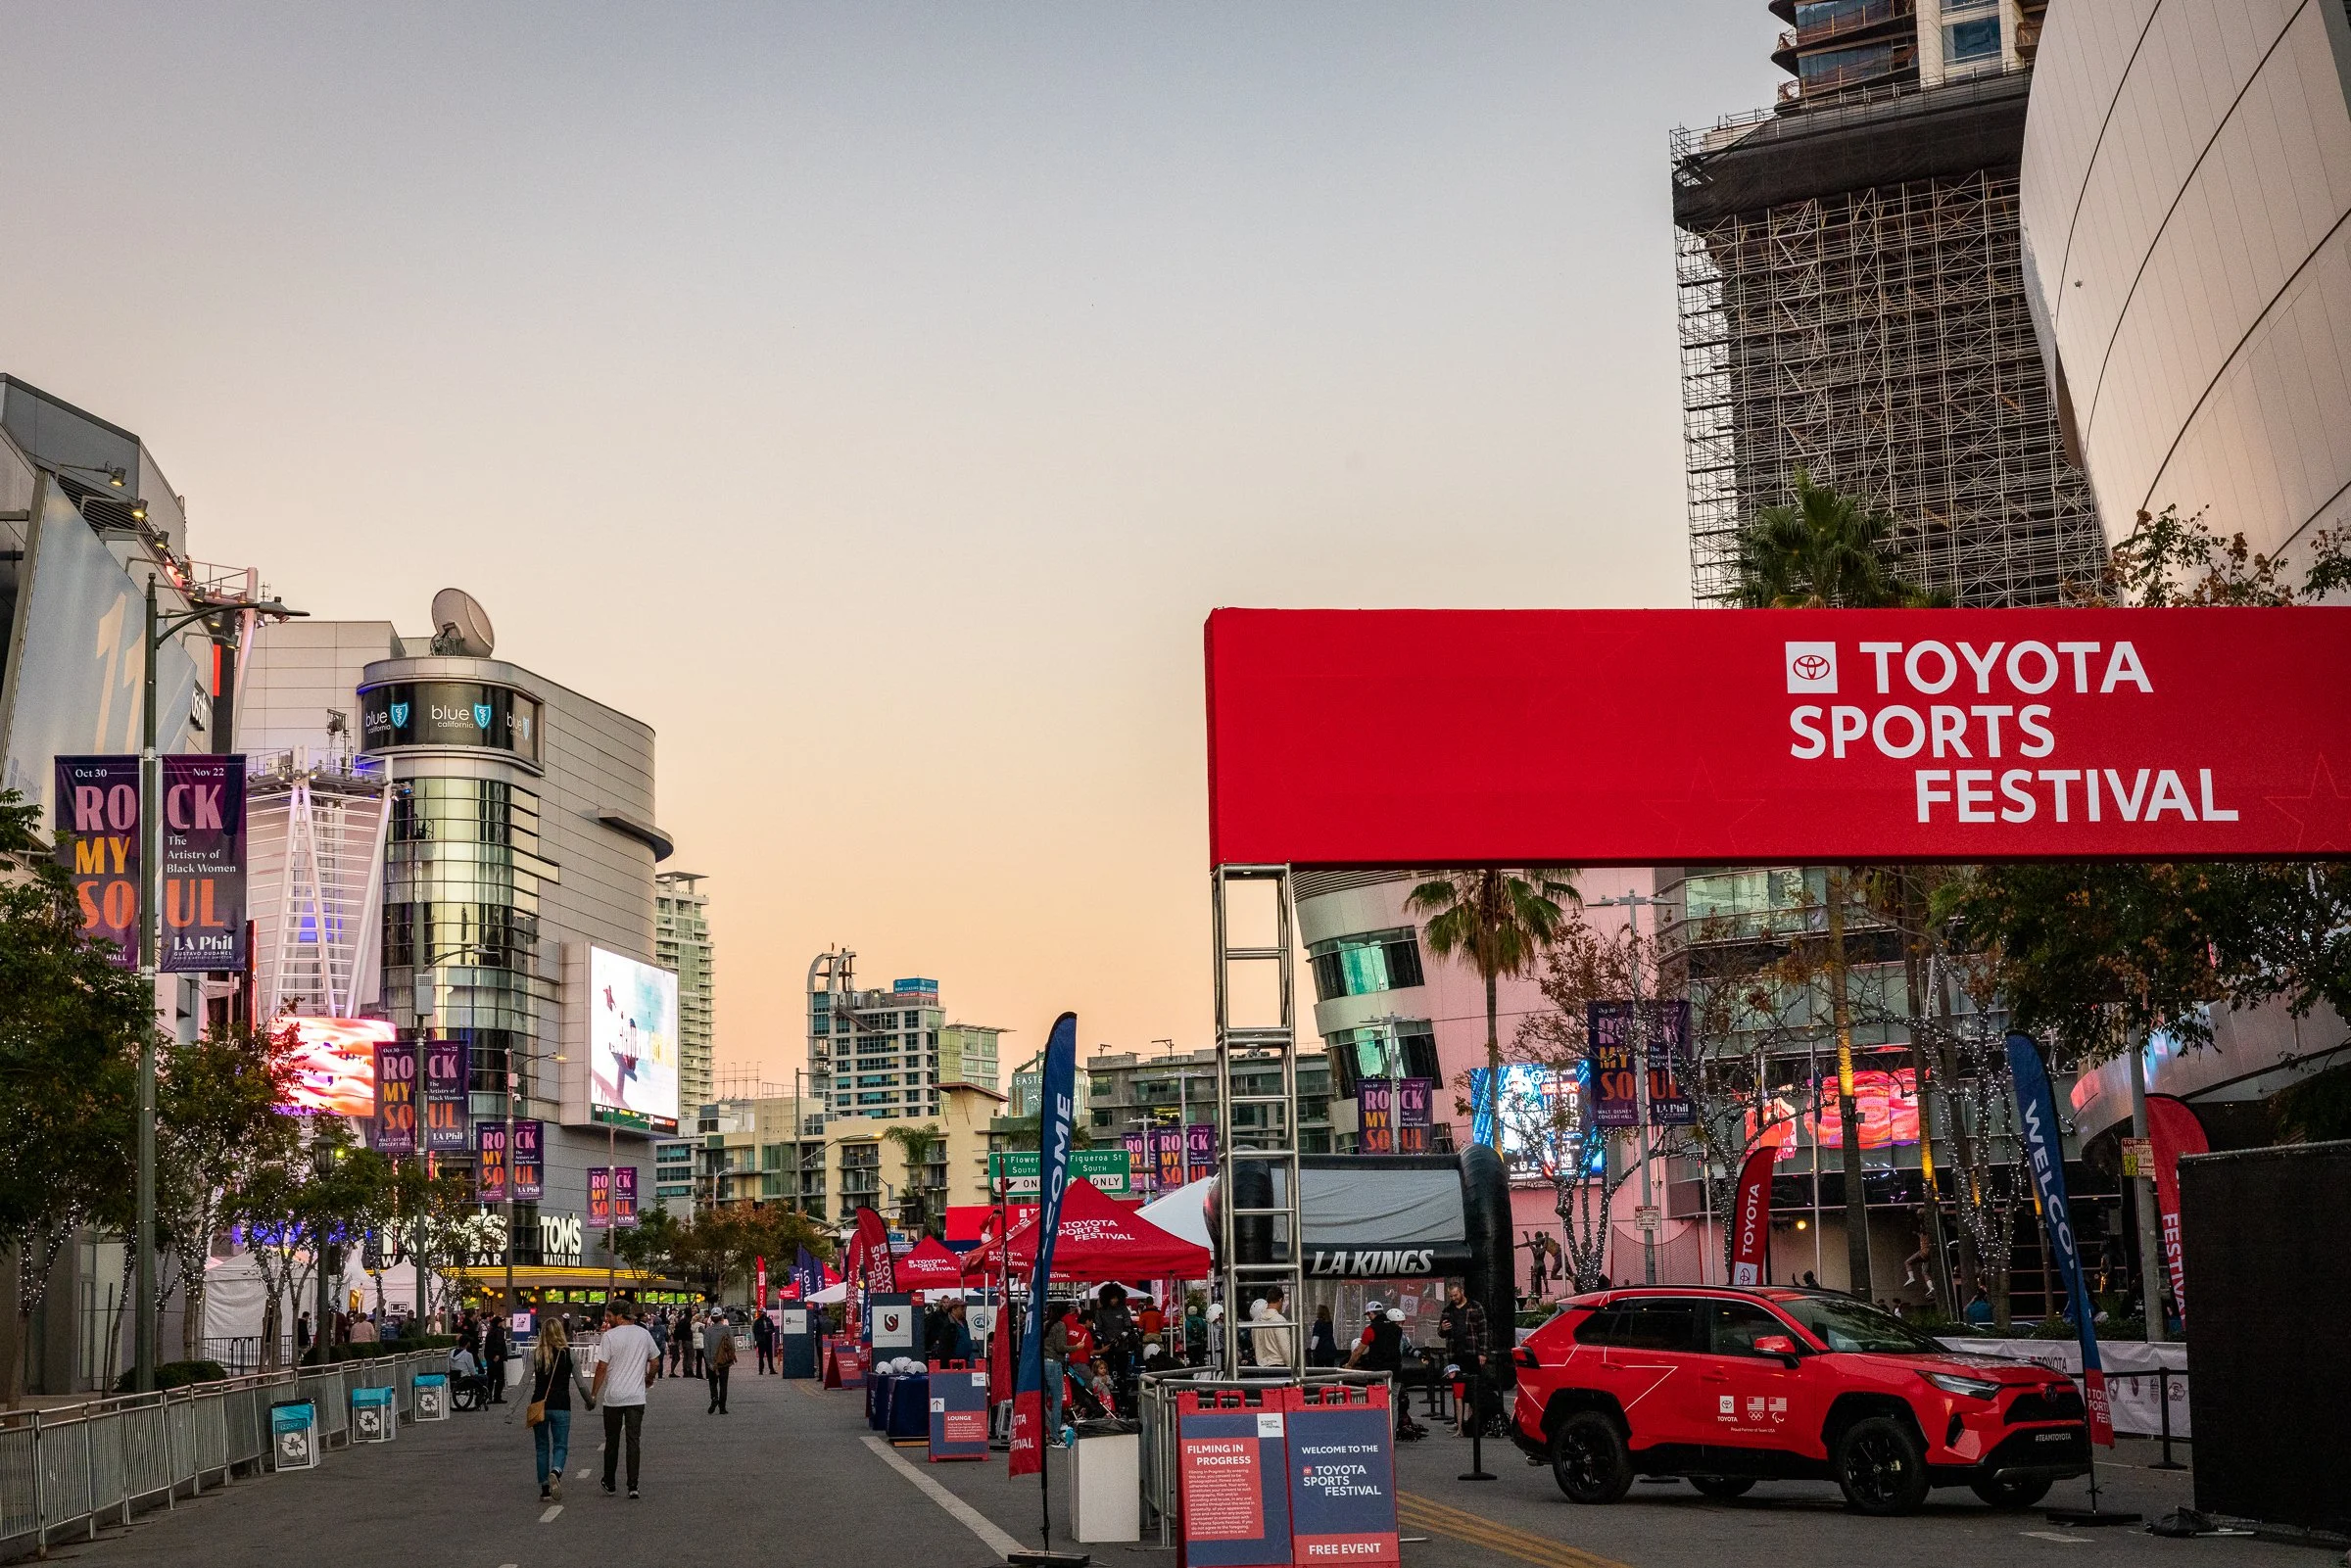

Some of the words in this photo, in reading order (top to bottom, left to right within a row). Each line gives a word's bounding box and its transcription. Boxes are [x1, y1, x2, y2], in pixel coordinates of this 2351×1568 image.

[1859, 640, 2154, 693] TOYOTA
[431, 705, 469, 720] blue
[365, 711, 387, 727] blue
[507, 712, 522, 732] blue
[368, 724, 391, 734] california
[1790, 704, 2055, 759] SPORTS
[75, 769, 93, 778] Oct
[95, 769, 107, 778] 30
[1914, 768, 2239, 824] FESTIVAL
[168, 836, 187, 845] The
[75, 837, 130, 874] MY
[168, 849, 207, 860] Artistry
[210, 849, 220, 858] of
[168, 864, 194, 873] Black
[174, 937, 195, 950] LA
[200, 935, 232, 950] Phil
[1600, 1047, 1628, 1069] MY
[1017, 1076, 1042, 1085] EASTE
[384, 1082, 410, 1102] MY
[1366, 1112, 1387, 1127] MY
[2124, 1146, 2134, 1155] NO
[483, 1151, 503, 1164] MY
[1161, 1153, 1178, 1165] MY
[2026, 1099, 2074, 1269] WELCO
[592, 1189, 606, 1200] MY
[1742, 1183, 1760, 1256] TOYOTA
[541, 1212, 582, 1254] TOM'S
[1056, 1226, 1100, 1236] PORTS
[1075, 1232, 1135, 1241] FESTIVAL
[544, 1255, 565, 1266] WATCH
[568, 1256, 580, 1266] BAR
[1310, 1252, 1348, 1275] LA
[1352, 1250, 1434, 1276] KINGS
[2038, 1357, 2067, 1372] TOYOTA
[2036, 1434, 2072, 1443] #TEAMTOYOTA
[1187, 1445, 1230, 1453] FILMING
[1302, 1446, 1347, 1454] WELCOME
[1197, 1456, 1251, 1465] PROGRESS
[1316, 1465, 1367, 1476] TOYOTA
[1304, 1475, 1350, 1487] SPORTS
[1324, 1486, 1381, 1497] FESTIVAL
[1309, 1544, 1338, 1555] FREE
[1342, 1543, 1381, 1553] EVENT
